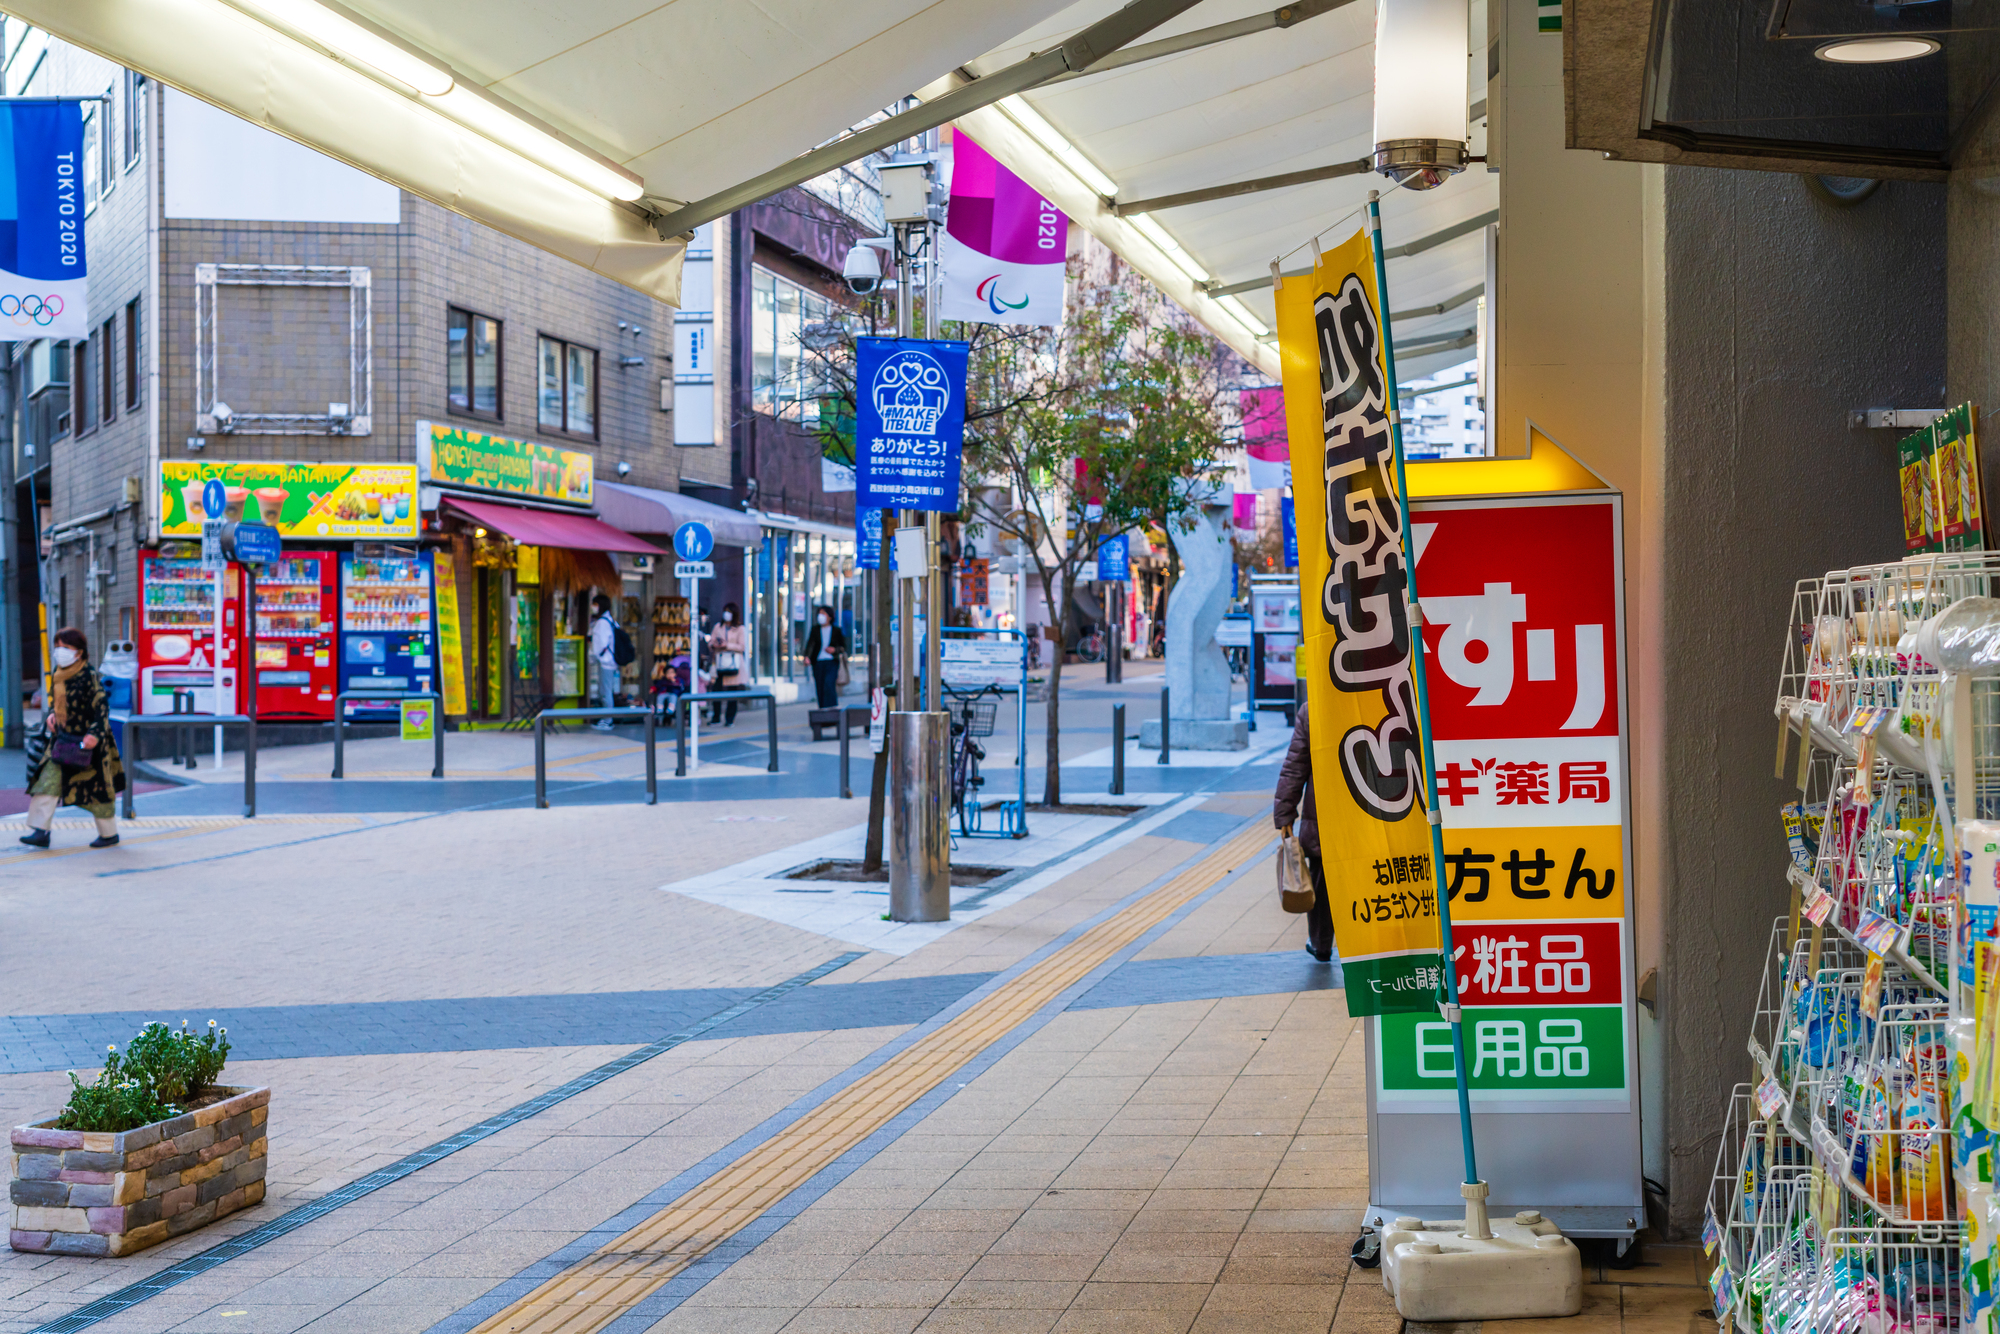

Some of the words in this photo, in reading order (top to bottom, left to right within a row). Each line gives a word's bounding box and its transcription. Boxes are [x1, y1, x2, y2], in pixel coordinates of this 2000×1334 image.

[57, 151, 76, 215] TOKYO
[1038, 200, 1057, 249] 2020
[60, 220, 77, 266] 2020
[884, 406, 936, 420] #MAKE
[438, 442, 472, 468] HONEY
[871, 437, 947, 456] ありがとう!
[163, 466, 227, 481] HONEY
[280, 468, 342, 483] BANANA
[332, 525, 357, 534] TAKE
[360, 525, 378, 534] THE
[380, 525, 413, 534] HONEY
[1411, 523, 1605, 729] すり
[1415, 1019, 1590, 1079] 日用品
